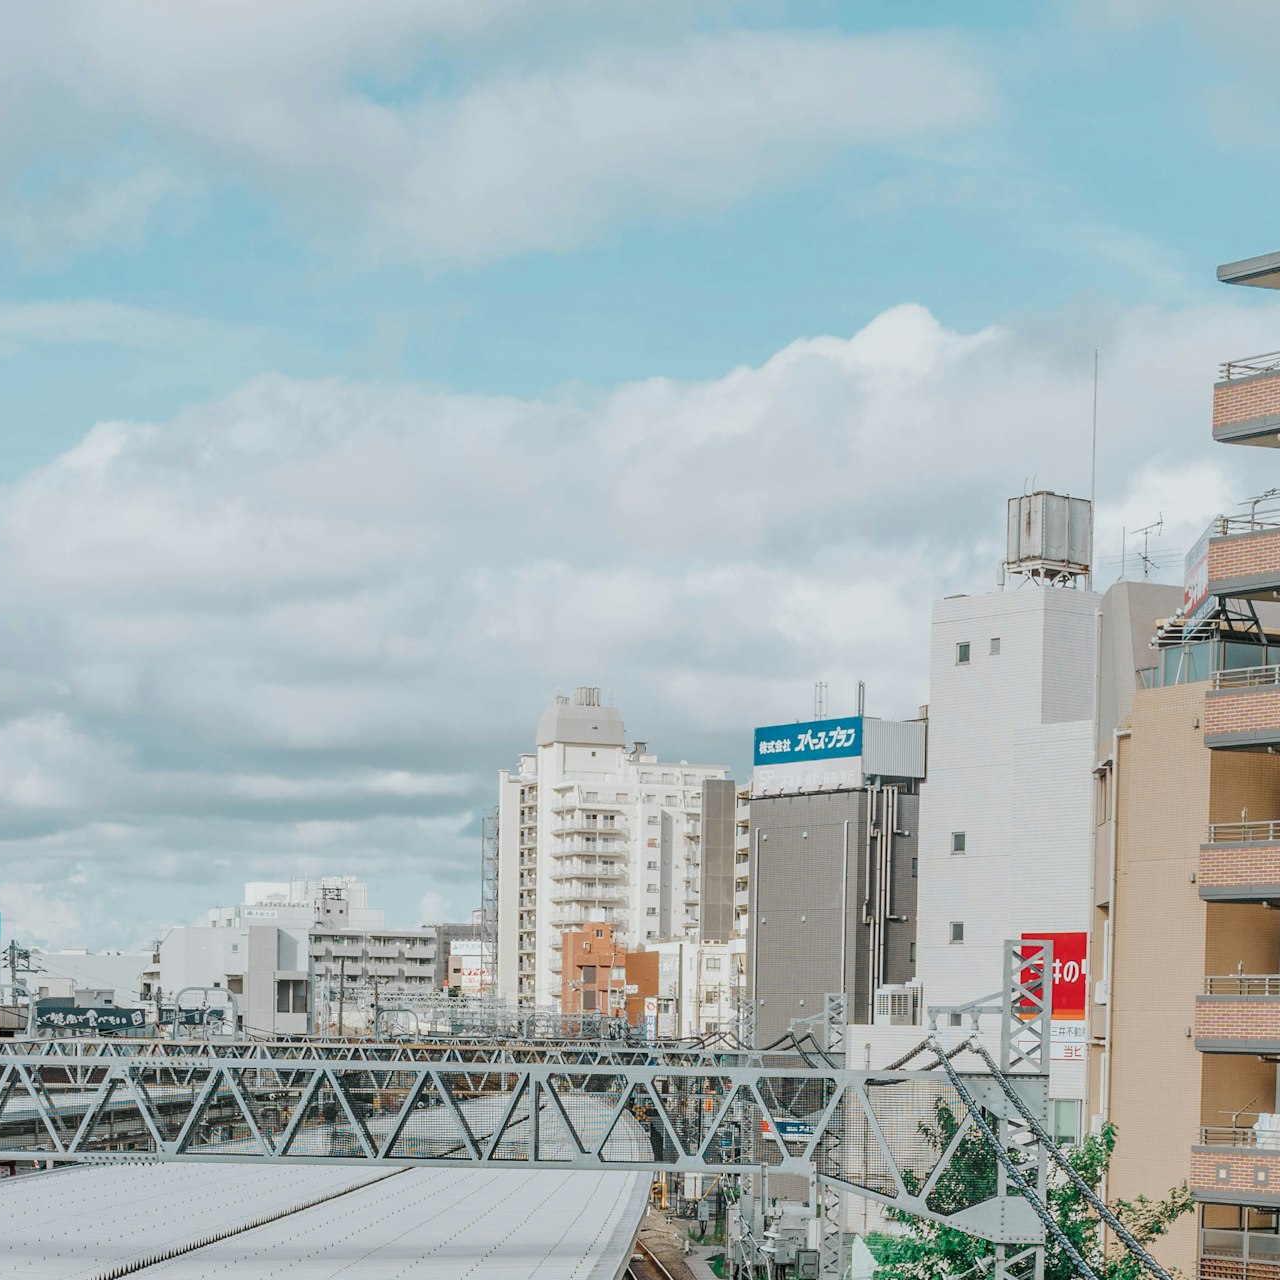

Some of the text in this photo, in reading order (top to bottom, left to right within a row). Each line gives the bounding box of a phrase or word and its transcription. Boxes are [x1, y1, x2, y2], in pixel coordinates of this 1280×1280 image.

[759, 726, 856, 755] 株式会社 スペース・プラン
